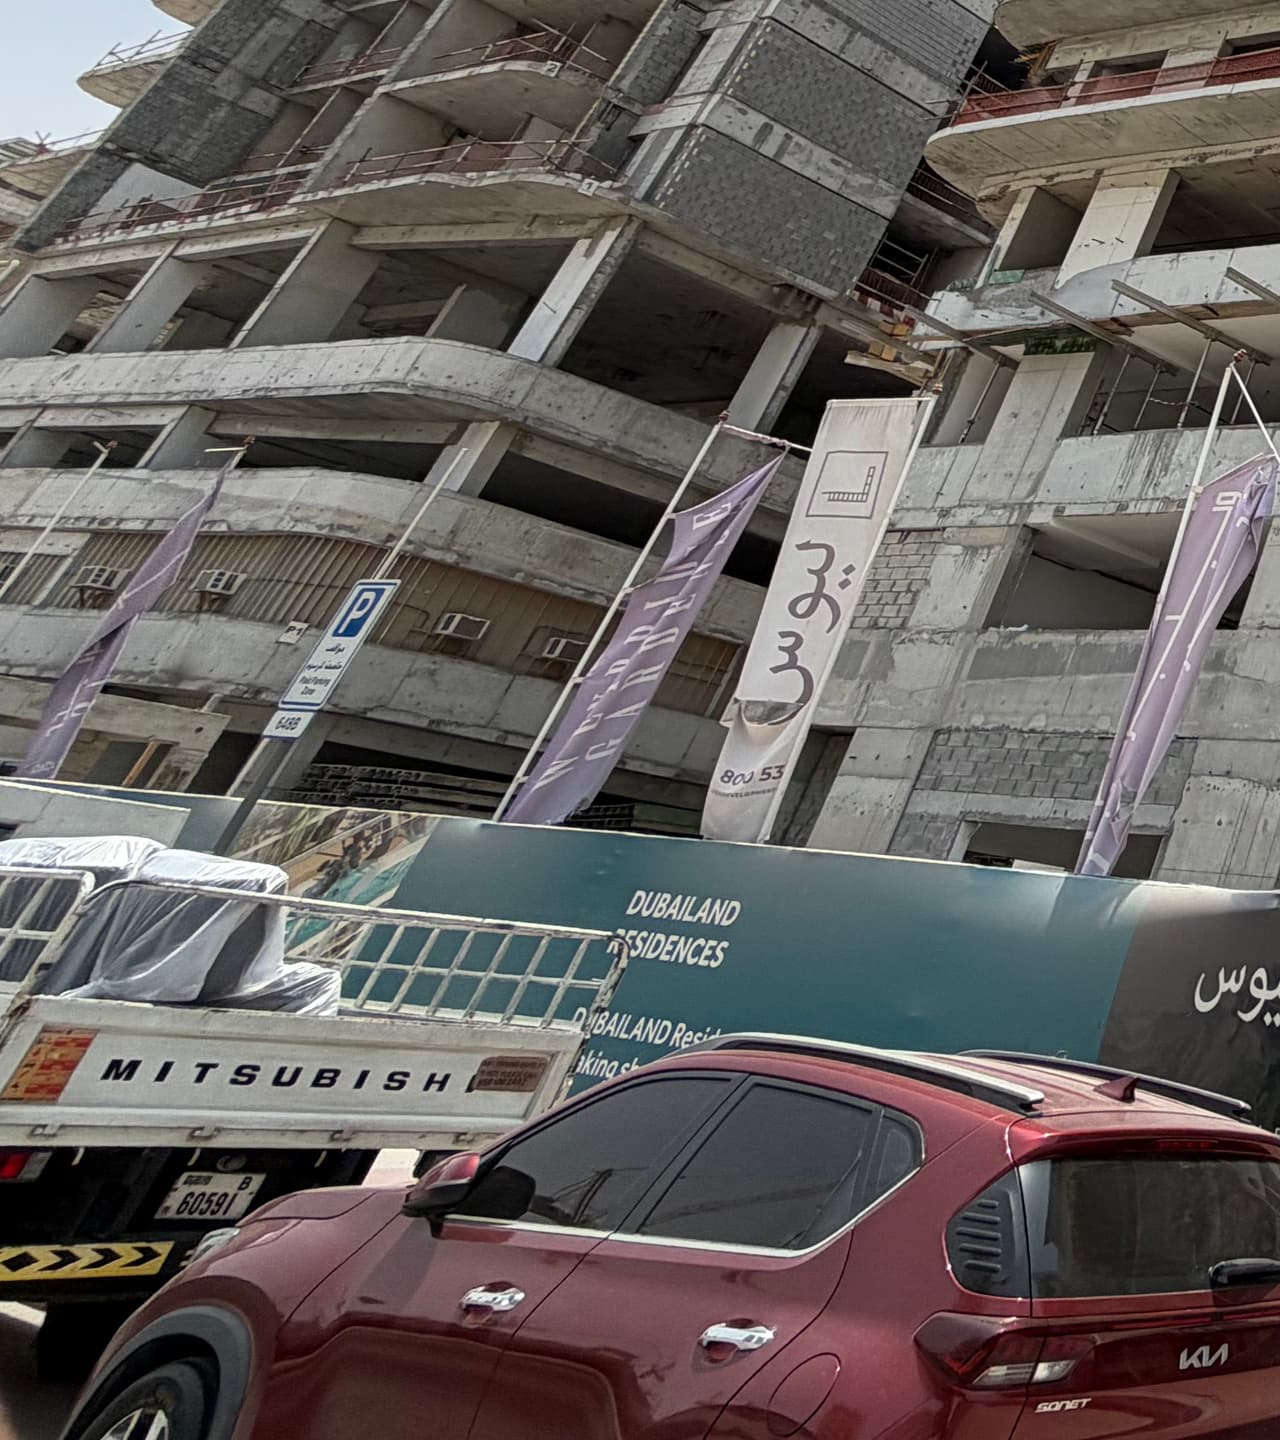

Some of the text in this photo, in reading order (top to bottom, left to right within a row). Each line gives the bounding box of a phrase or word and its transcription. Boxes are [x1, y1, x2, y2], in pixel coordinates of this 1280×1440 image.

[625, 890, 742, 927] DUBAILAND
[237, 1176, 253, 1192] B
[175, 1191, 240, 1216] 60591
[1179, 1343, 1229, 1370] KIA
[1035, 1398, 1092, 1413] SONET
